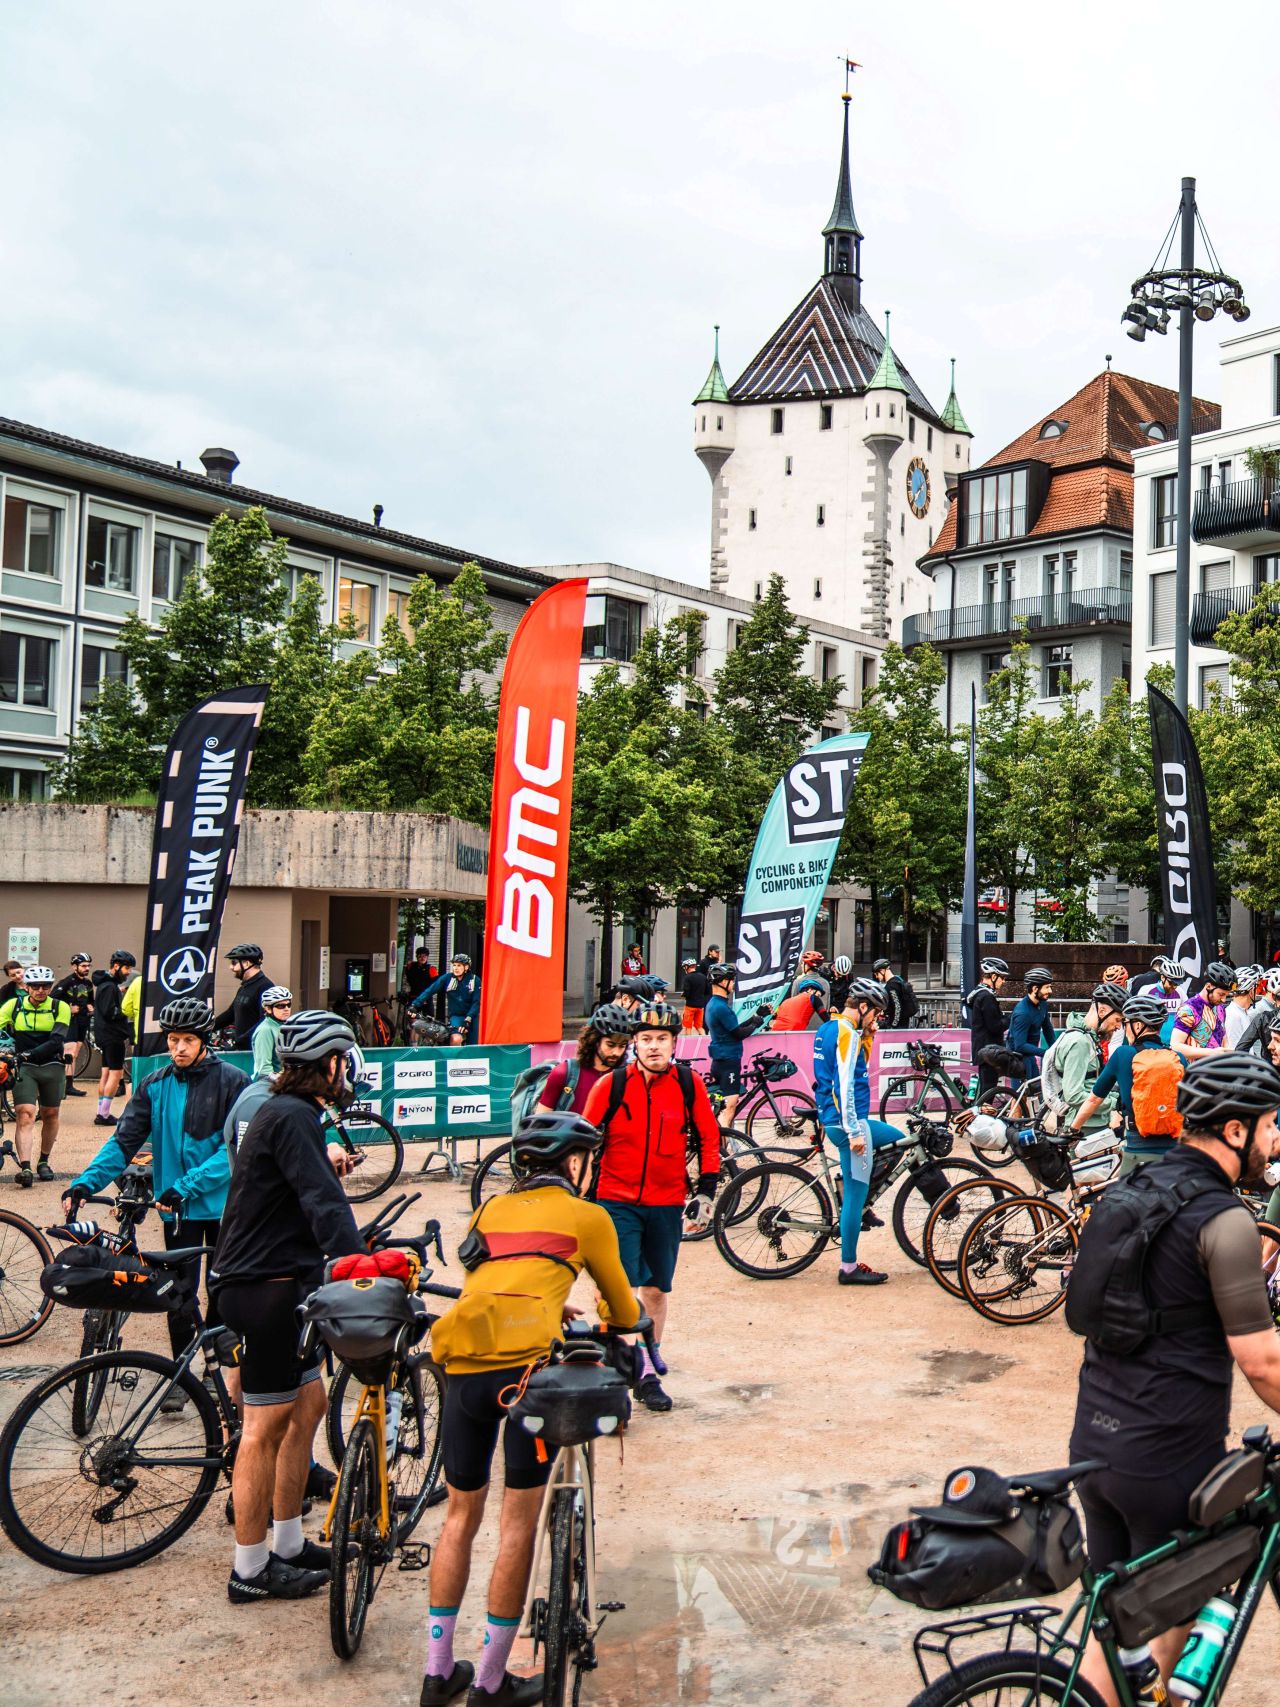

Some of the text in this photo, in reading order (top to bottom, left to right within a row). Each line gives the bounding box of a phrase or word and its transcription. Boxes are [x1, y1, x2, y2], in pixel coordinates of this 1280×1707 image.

[789, 759, 849, 818] ST
[496, 705, 566, 959] BMC
[755, 858, 829, 880] CYCLING & BIKE
[761, 874, 824, 894] COMPONENTS
[182, 849, 220, 934] PEAK
[737, 918, 788, 974] ST
[409, 1070, 433, 1078] GIRO
[451, 1104, 487, 1115] BMC
